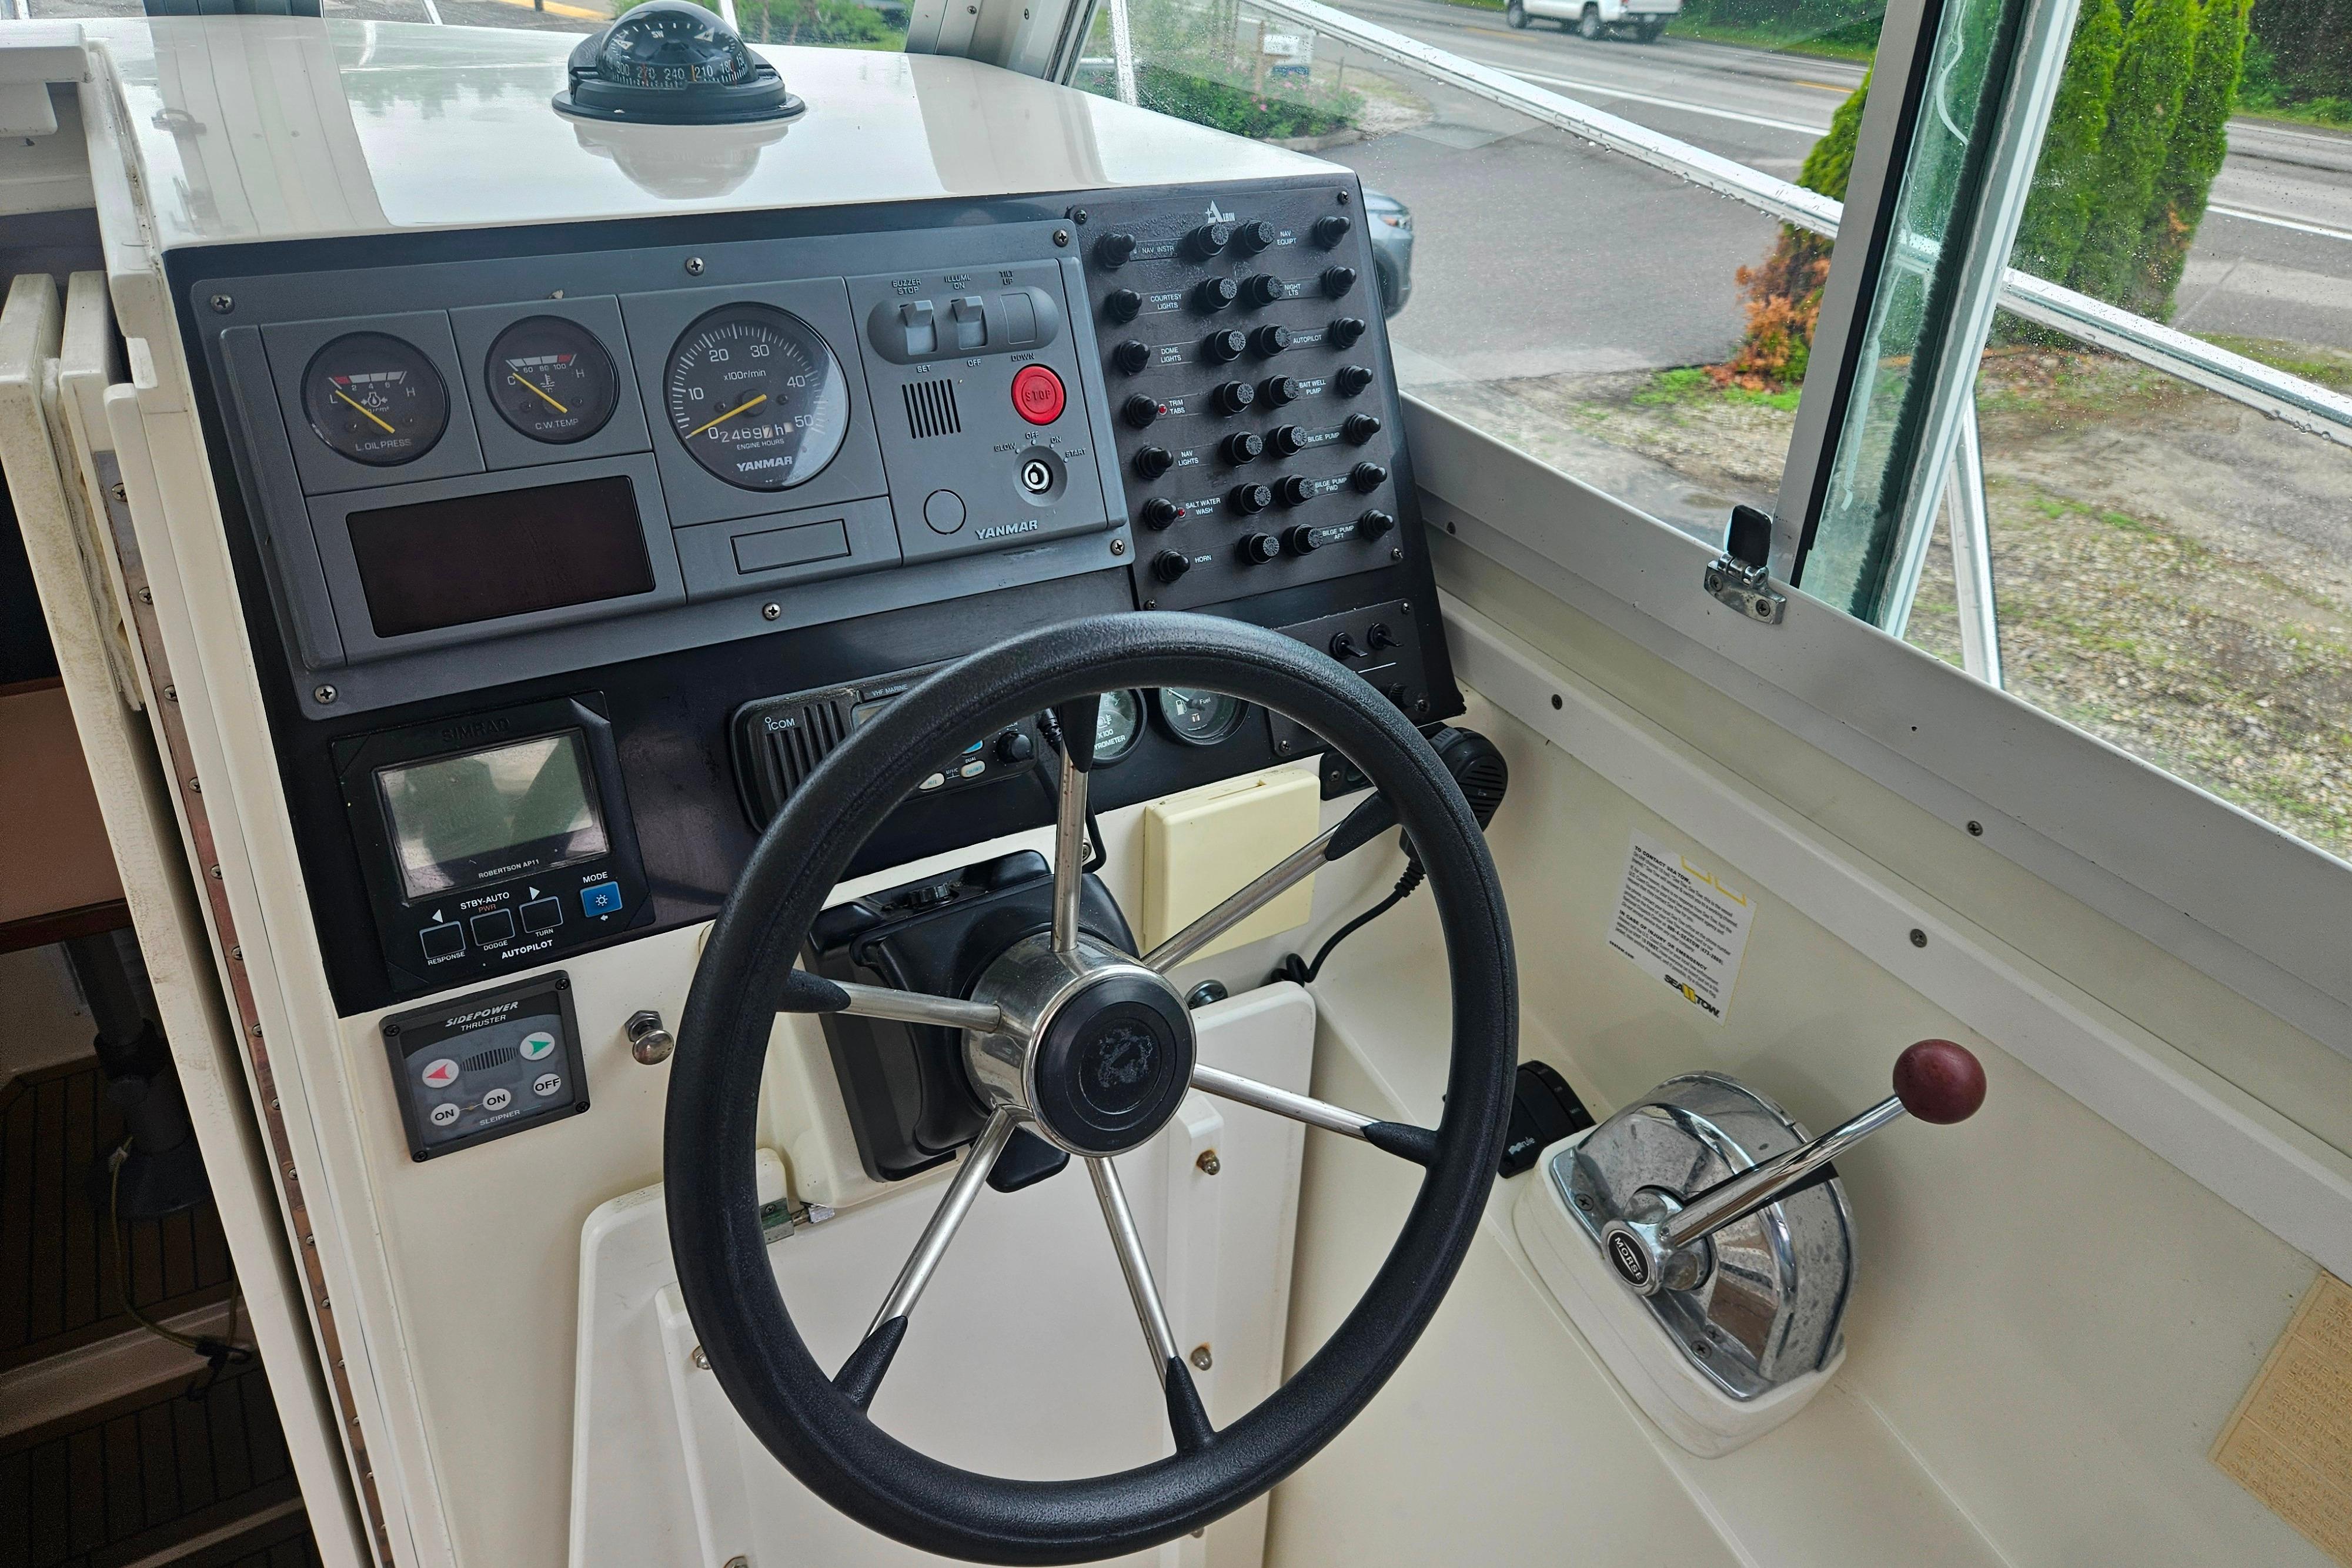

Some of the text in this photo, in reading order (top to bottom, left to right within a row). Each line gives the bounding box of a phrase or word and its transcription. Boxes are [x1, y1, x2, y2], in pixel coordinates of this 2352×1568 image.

[664, 68, 684, 81] 240
[695, 65, 713, 78] 210
[892, 279, 921, 288] BUZZER
[954, 282, 965, 290] ON
[1003, 277, 1014, 285] UP
[898, 286, 918, 295] STOP
[1150, 293, 1182, 303] COURTESY
[1157, 302, 1178, 310] LIGHTS
[1293, 335, 1322, 344] AUTOPILOT
[709, 348, 729, 362] 20
[750, 344, 770, 358] 30
[1161, 347, 1179, 355] DOME
[967, 359, 981, 367] OFF
[1011, 353, 1035, 362] DOWN
[1161, 354, 1182, 363] LIGHTS
[576, 369, 585, 378] H
[917, 365, 931, 373] SET
[507, 376, 516, 385] C
[723, 369, 766, 382] x100r/min
[787, 375, 806, 388] 40
[406, 387, 415, 397] H
[689, 387, 704, 400] 10
[1025, 389, 1051, 401] STOP
[330, 394, 338, 404] L
[794, 414, 814, 427] 50
[708, 426, 719, 440] 0
[1025, 431, 1039, 440] OFF
[736, 439, 784, 450] ENGINE HOURS
[994, 442, 1016, 452] GLOW
[1065, 447, 1087, 457] START
[736, 456, 793, 472] YANMAR
[1178, 457, 1198, 466] LIGHTS
[1200, 498, 1221, 507] WATER
[975, 520, 1038, 540] YANMAR
[1195, 555, 1211, 563] HORN
[442, 718, 511, 741] SIMRAD
[1094, 735, 1126, 750] YROMETER
[1634, 845, 1641, 853] TO
[1642, 850, 1666, 868] CONTACT
[1666, 865, 1677, 875] SEA
[478, 859, 540, 879] ROBERTSON AP11
[582, 871, 608, 884] MODE
[460, 892, 510, 911] STBY-AUTO
[478, 904, 496, 912] PWR
[535, 928, 554, 937] TURN
[483, 940, 508, 951] DODGE
[1625, 913, 1639, 926] CASE
[1639, 922, 1646, 931] OF
[1648, 928, 1666, 944] INJURY
[1667, 941, 1674, 950] OR
[1675, 947, 1708, 972] EMERGENCY
[501, 940, 553, 959] AUTOPILOT
[427, 951, 466, 966] RESPONSE
[1663, 972, 1685, 994] SEA
[445, 1001, 519, 1028] SIDEPOWER
[461, 1015, 506, 1032] THRUSTER
[534, 1078, 560, 1092] OFF
[487, 1094, 506, 1106] ON
[435, 1109, 455, 1121] ON
[479, 1109, 521, 1126] SLEIPNER
[1615, 1236, 1644, 1281] MORSE
